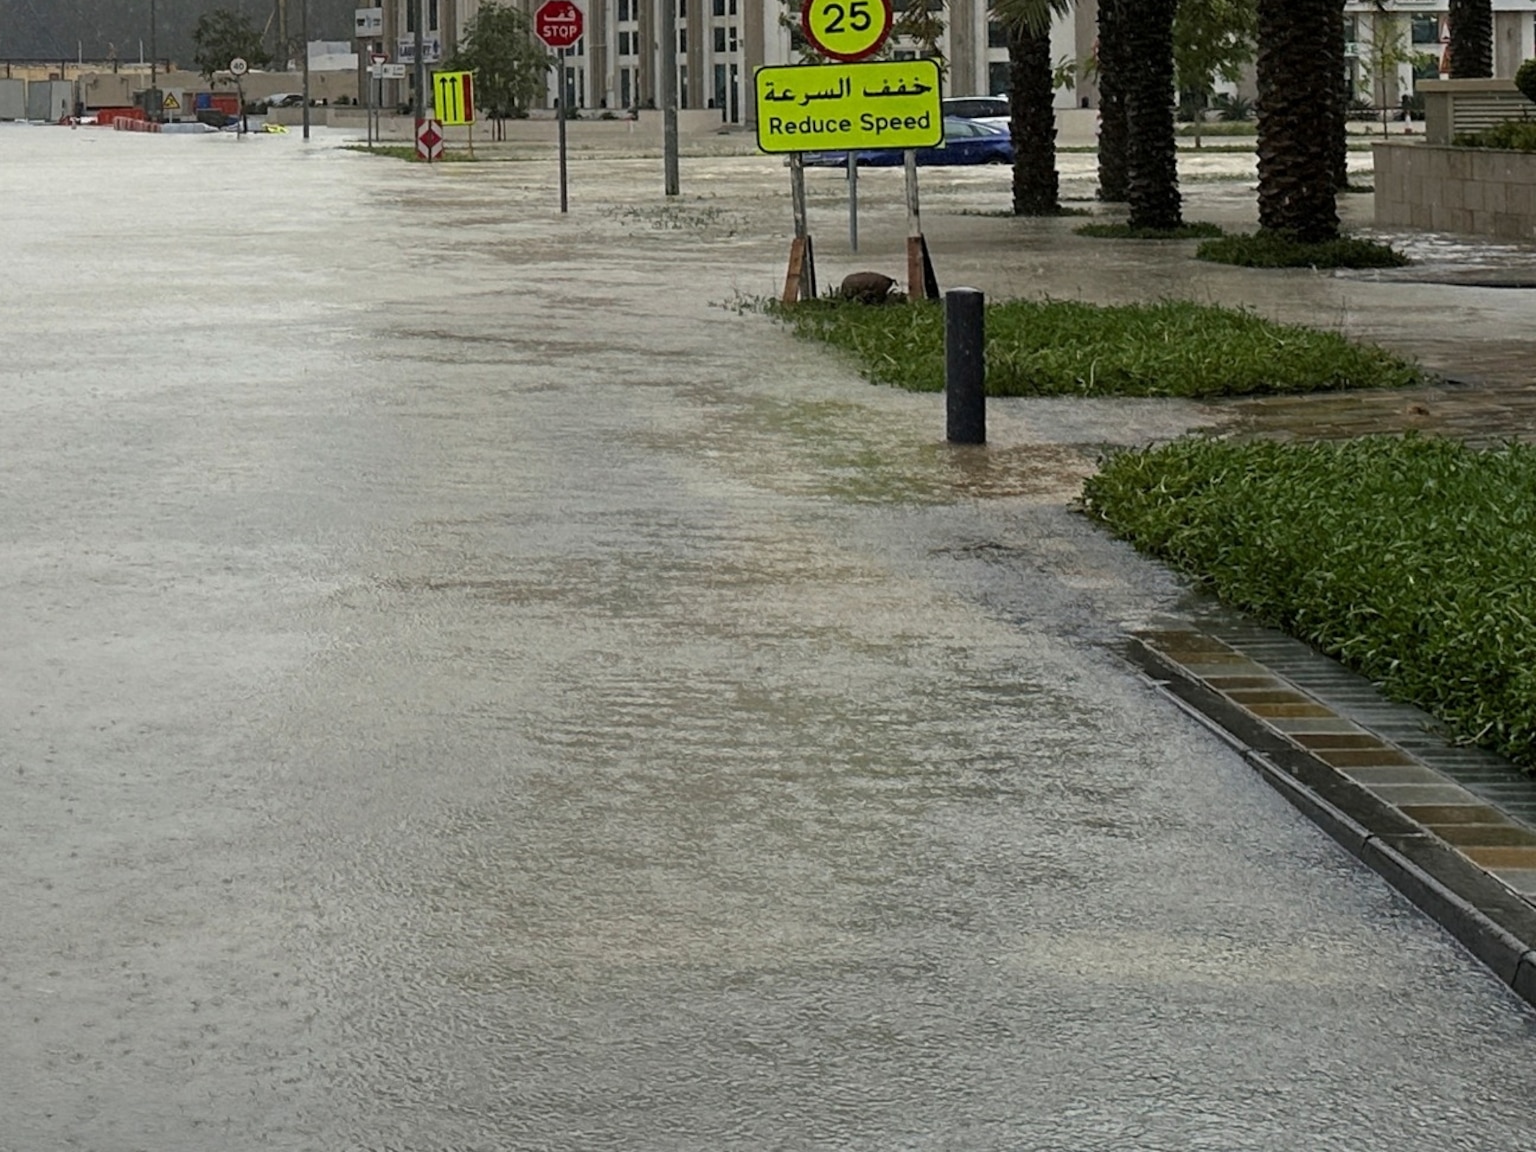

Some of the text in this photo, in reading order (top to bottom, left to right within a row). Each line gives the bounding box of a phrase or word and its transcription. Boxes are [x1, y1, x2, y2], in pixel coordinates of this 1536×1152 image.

[543, 5, 576, 22] قف
[822, 1, 872, 34] 25
[543, 25, 577, 38] STOP
[233, 62, 245, 70] 40
[764, 76, 932, 106] خفف السرعة
[769, 110, 930, 135] Reduce Speed
